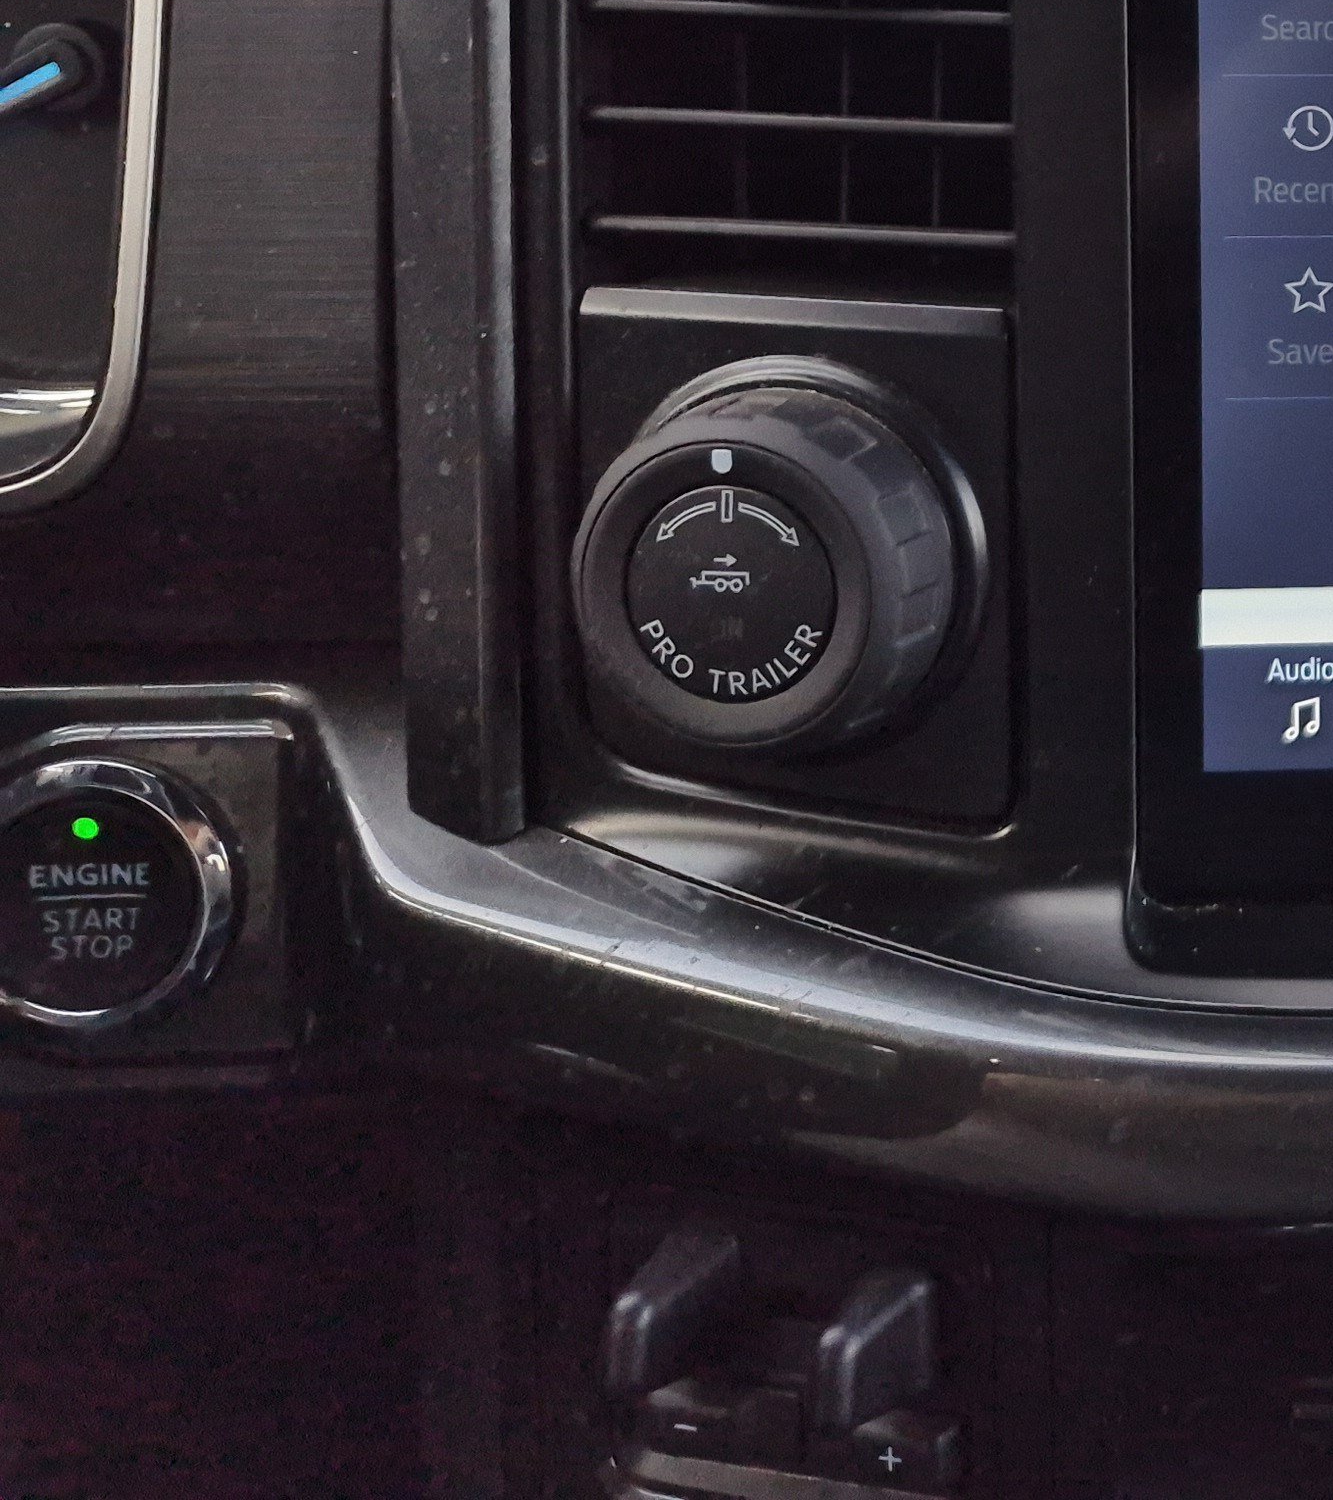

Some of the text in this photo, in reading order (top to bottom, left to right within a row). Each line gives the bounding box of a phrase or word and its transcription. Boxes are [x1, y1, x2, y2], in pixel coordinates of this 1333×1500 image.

[639, 619, 823, 696] PRO TRAILER
[29, 862, 150, 889] ENGINE
[42, 907, 140, 933] START
[50, 934, 134, 961] STOP
